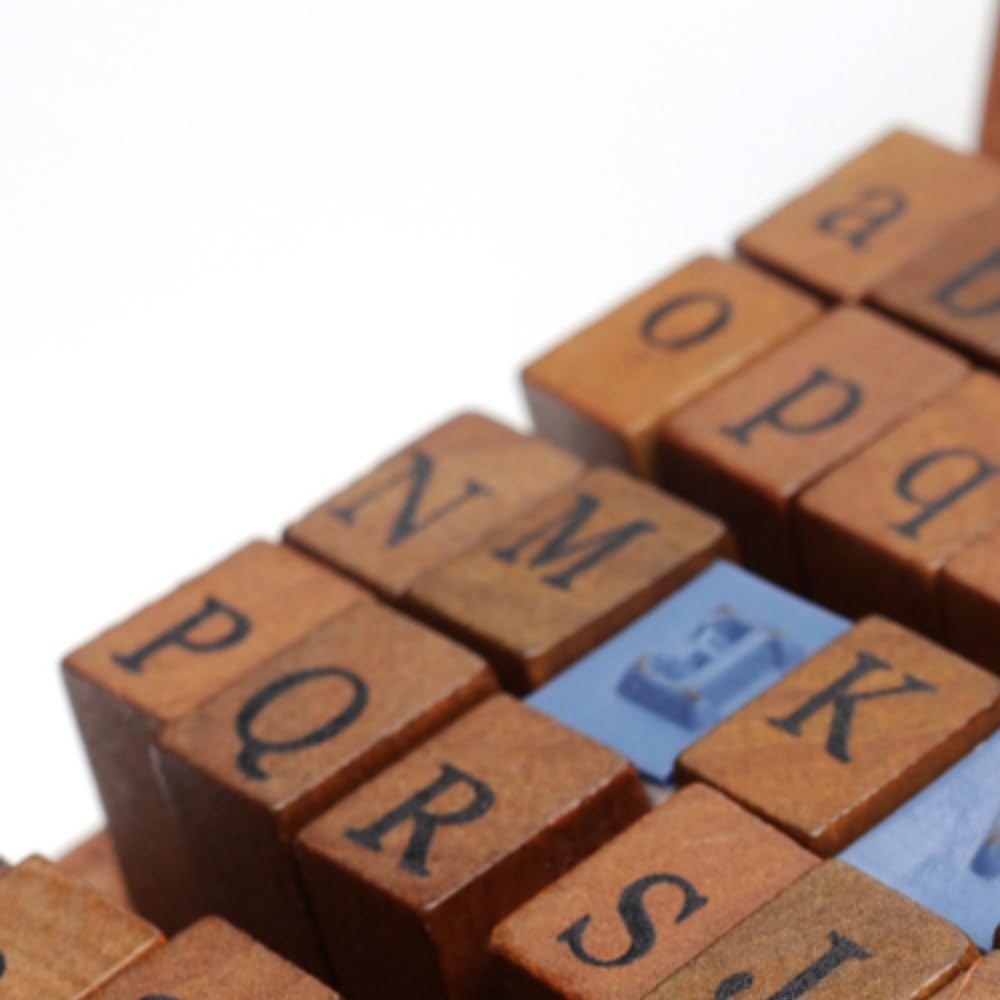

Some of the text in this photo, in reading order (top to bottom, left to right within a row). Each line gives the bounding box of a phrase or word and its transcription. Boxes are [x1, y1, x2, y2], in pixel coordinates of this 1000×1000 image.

[817, 186, 909, 249] a
[721, 368, 863, 446] p
[328, 451, 491, 549] N
[492, 493, 659, 591] M
[894, 450, 999, 539] q
[112, 597, 252, 673] P
[235, 668, 369, 782] Q
[767, 651, 937, 763] K
[345, 764, 495, 877] R
[559, 874, 707, 968] S
